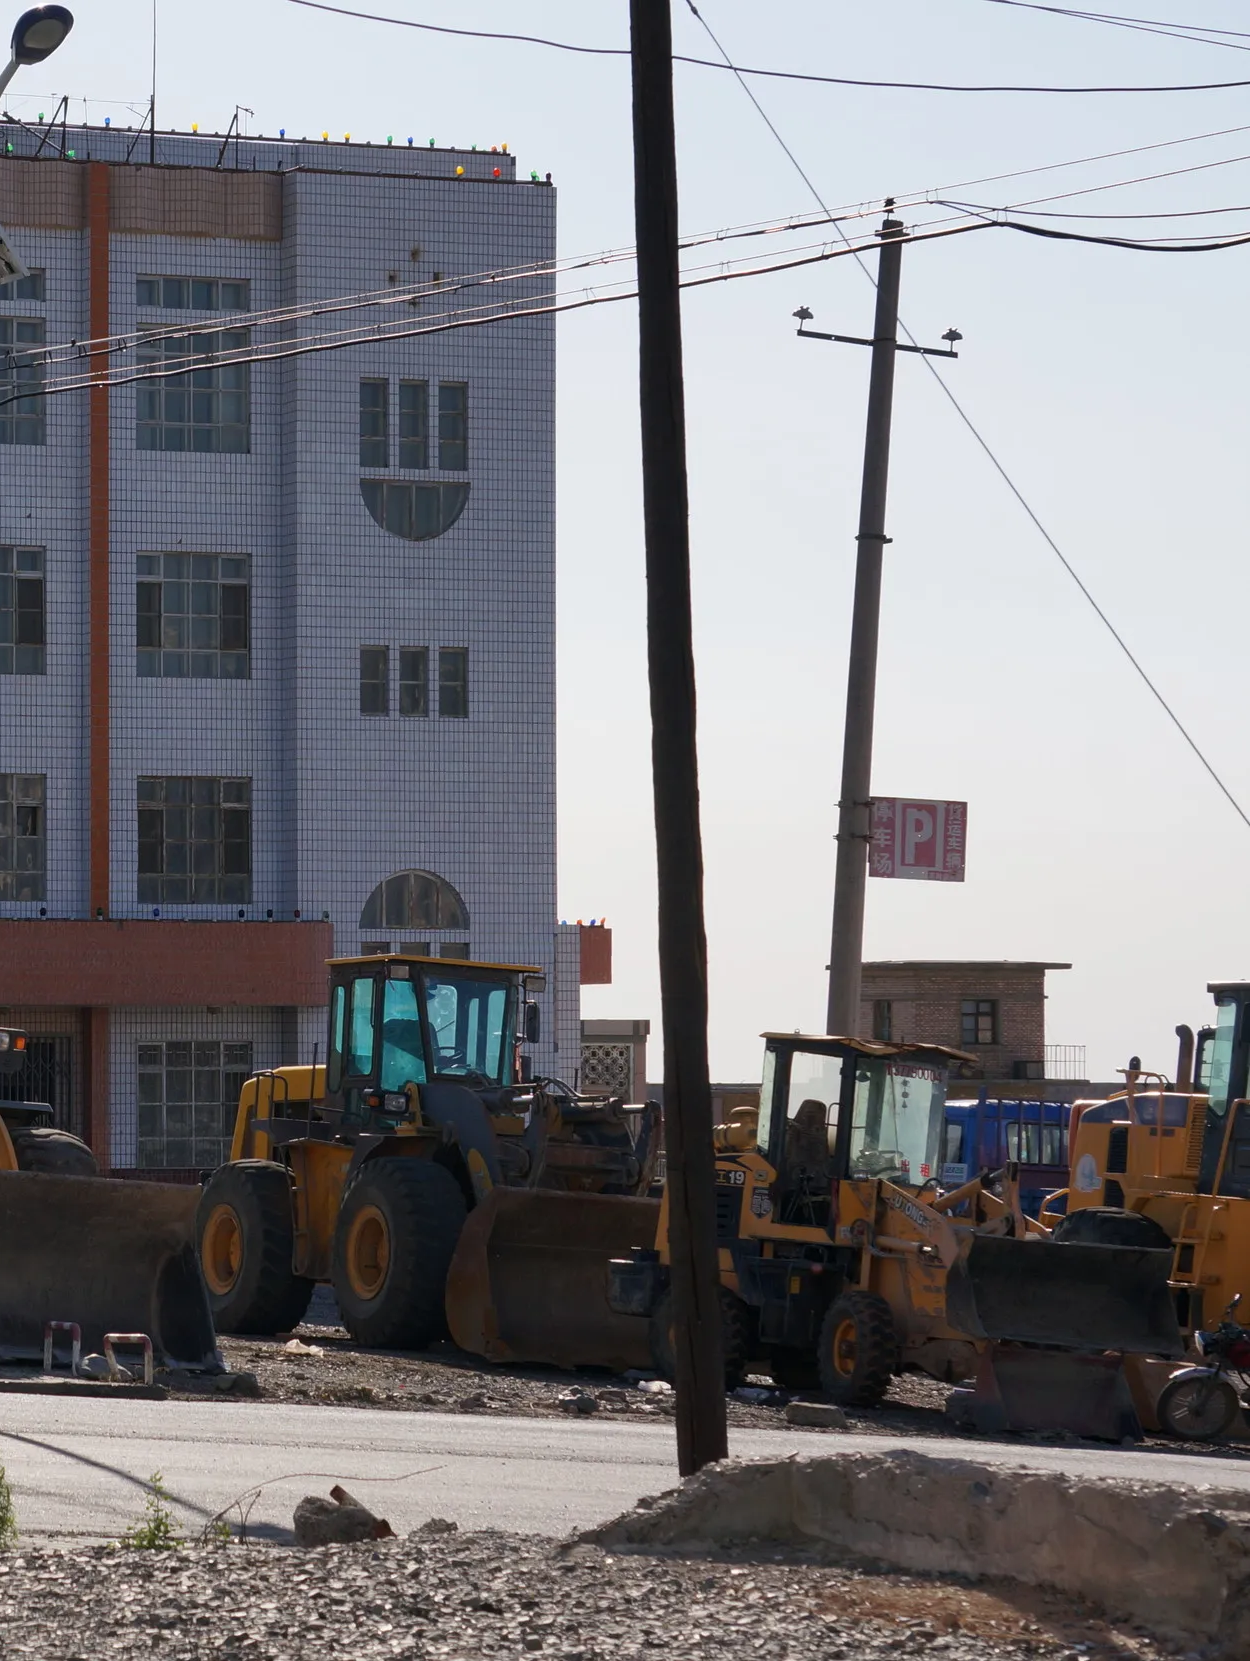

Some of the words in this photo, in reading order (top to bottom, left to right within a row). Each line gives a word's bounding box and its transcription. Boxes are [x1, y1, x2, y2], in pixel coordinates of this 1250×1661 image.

[872, 801, 894, 873] 停车场
[905, 808, 934, 864] P
[729, 1171, 745, 1185] 19
